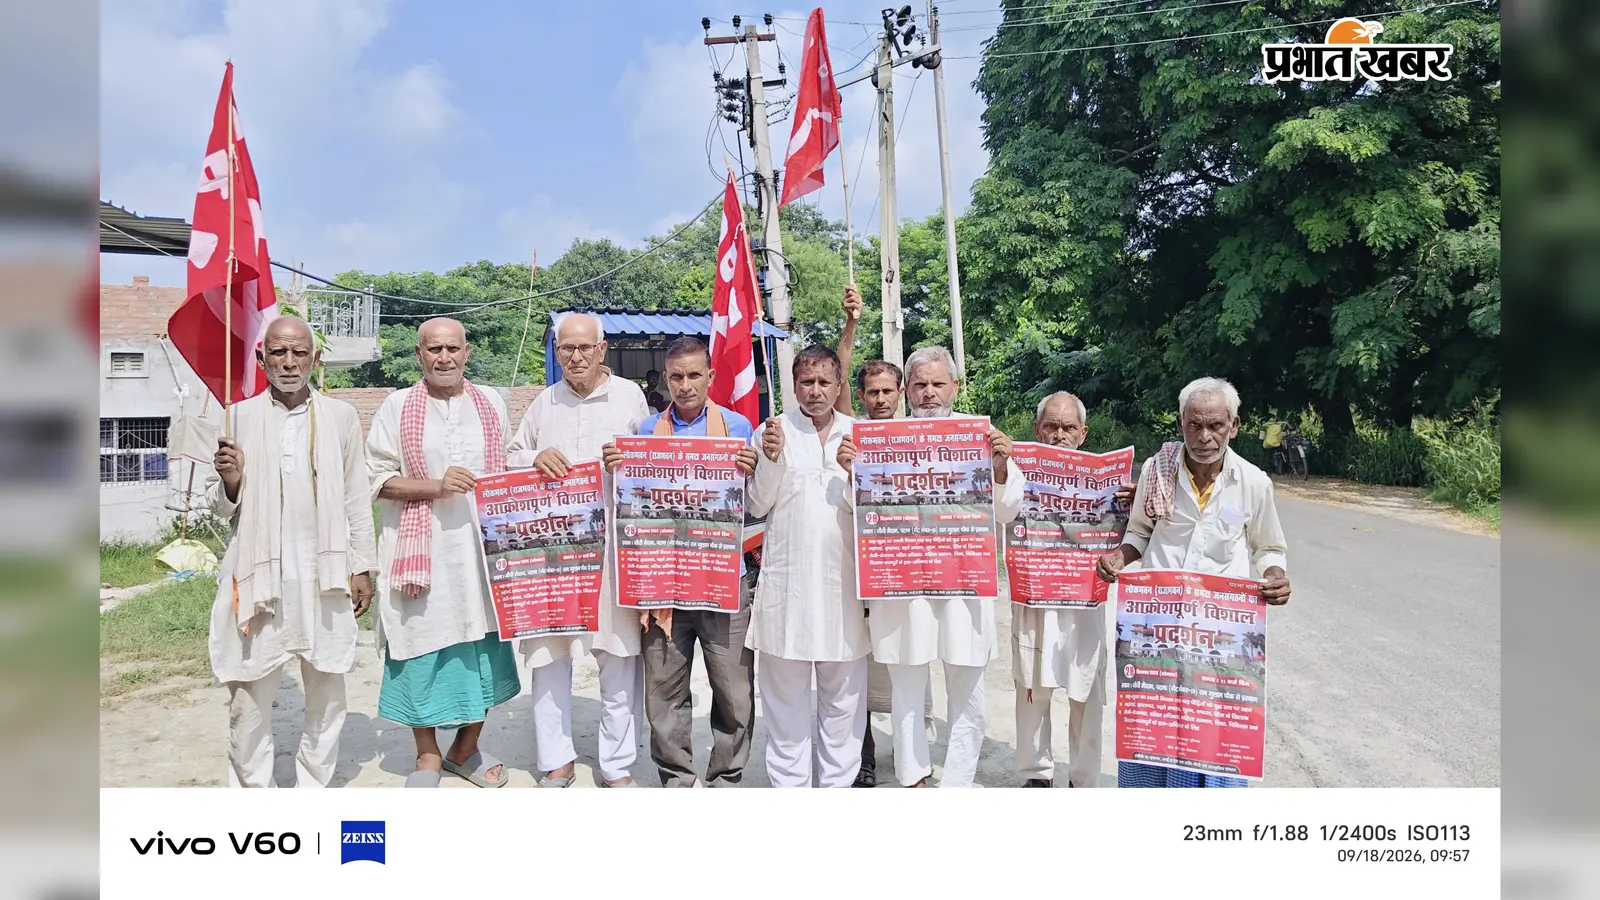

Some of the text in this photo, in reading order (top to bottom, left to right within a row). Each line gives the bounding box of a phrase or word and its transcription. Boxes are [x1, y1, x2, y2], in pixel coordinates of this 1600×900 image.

[919, 433, 925, 442] के
[678, 450, 683, 460] के
[862, 446, 983, 467] आक्रोशपूर्ण विशाल
[624, 462, 737, 483] आक्रोशपूर्ण विशाल
[892, 468, 950, 491] प्रदर्शन
[1084, 475, 1123, 491] विशाल
[540, 482, 545, 490] के
[651, 484, 703, 506] प्रदर्शन
[486, 490, 598, 516] आक्रोशपूर्ण विशाल
[1039, 492, 1094, 512] प्रदर्शन
[516, 512, 569, 538] प्रदर्शन
[1125, 584, 1152, 594] लोकभवन
[1186, 585, 1192, 595] के
[1248, 595, 1258, 604] का
[1126, 598, 1256, 625] आक्रोशपूर्ण विशाल
[1154, 623, 1216, 649] प्रदर्शन
